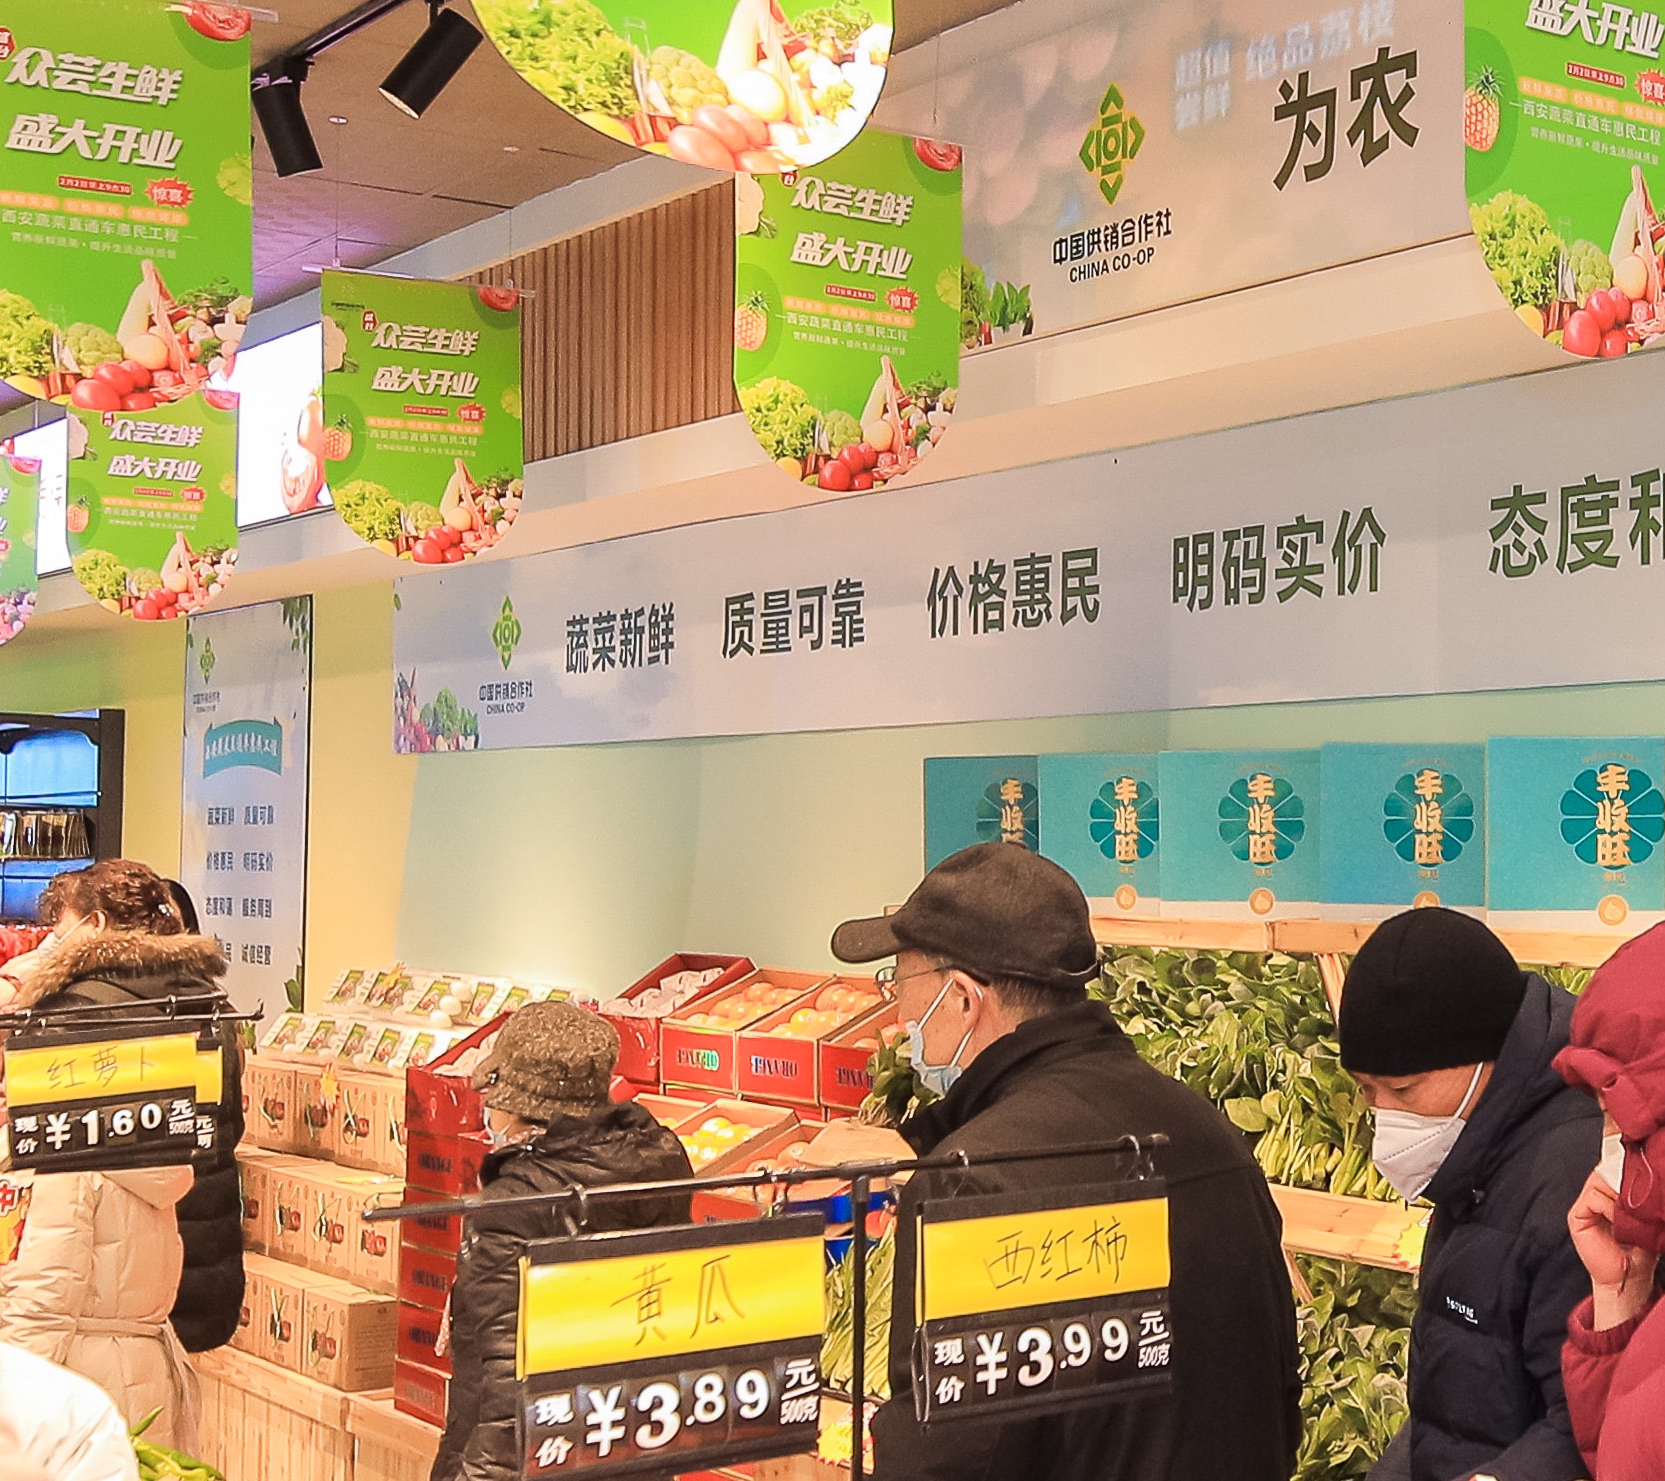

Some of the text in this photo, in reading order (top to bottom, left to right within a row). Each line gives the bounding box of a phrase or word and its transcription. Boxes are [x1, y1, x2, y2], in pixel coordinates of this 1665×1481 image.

[4, 47, 183, 106] 众芸生鲜
[1641, 78, 1665, 100] 惊喜
[4, 113, 183, 169] 盛大开业
[1272, 45, 1421, 192] 为农
[1523, 100, 1662, 146] 西安蔬菜直通车惠民工程
[791, 176, 914, 226] 众芸生鲜
[790, 231, 913, 279] 盛大开业
[1052, 207, 1173, 267] 中国供销合作社
[1069, 246, 1156, 284] CHINA CO-OP
[371, 322, 480, 356] 众芸生鲜
[371, 365, 480, 398] 盛大开业
[109, 419, 203, 448] 众芸生鲜
[107, 454, 203, 482] 盛大开业
[1169, 505, 1388, 617] 明码实价
[720, 577, 867, 659] 质量可靠
[926, 546, 1102, 640] 价格惠民
[563, 601, 676, 676] 蔬菜新鲜
[1112, 776, 1138, 863] 丰收旺
[1247, 772, 1277, 865] 丰收旺
[1414, 767, 1446, 866] 丰收旺
[1596, 762, 1631, 868] 丰收旺
[14, 1116, 38, 1155] 现价
[45, 1103, 162, 1150] ¥1.60
[169, 1099, 194, 1120] 元
[985, 1217, 1129, 1291] 西红柿
[611, 1254, 748, 1347] 黄瓜
[1138, 1309, 1166, 1336] 元
[785, 1358, 817, 1389] 元
[934, 1337, 965, 1405] 现价
[974, 1320, 1130, 1397] ¥3.99
[535, 1393, 573, 1468] 现价
[584, 1370, 771, 1458] ¥3.89
